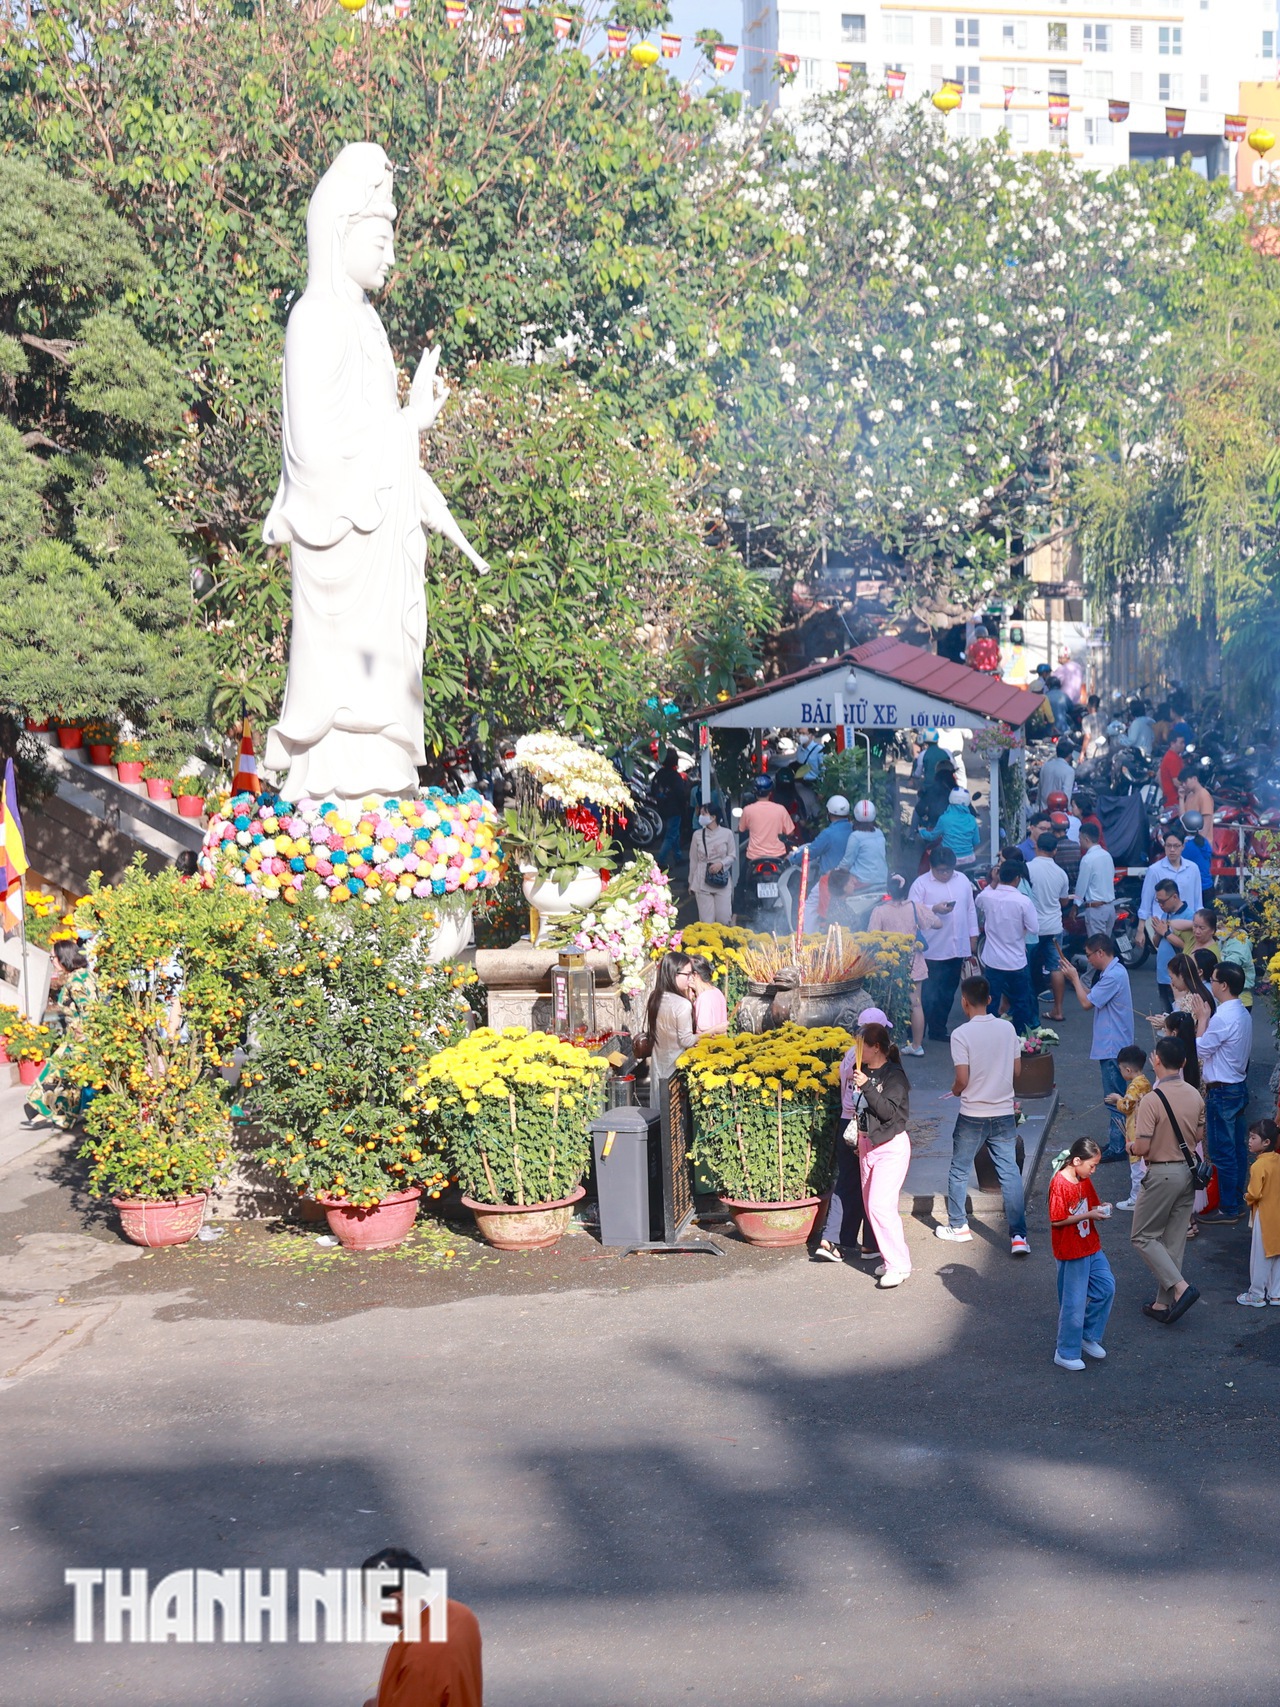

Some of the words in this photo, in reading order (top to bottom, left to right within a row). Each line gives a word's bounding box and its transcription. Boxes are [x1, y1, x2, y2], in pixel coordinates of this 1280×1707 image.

[801, 698, 832, 724] BÃI
[873, 704, 898, 725] XE
[911, 711, 929, 727] LỐI
[932, 711, 955, 727] VÀO
